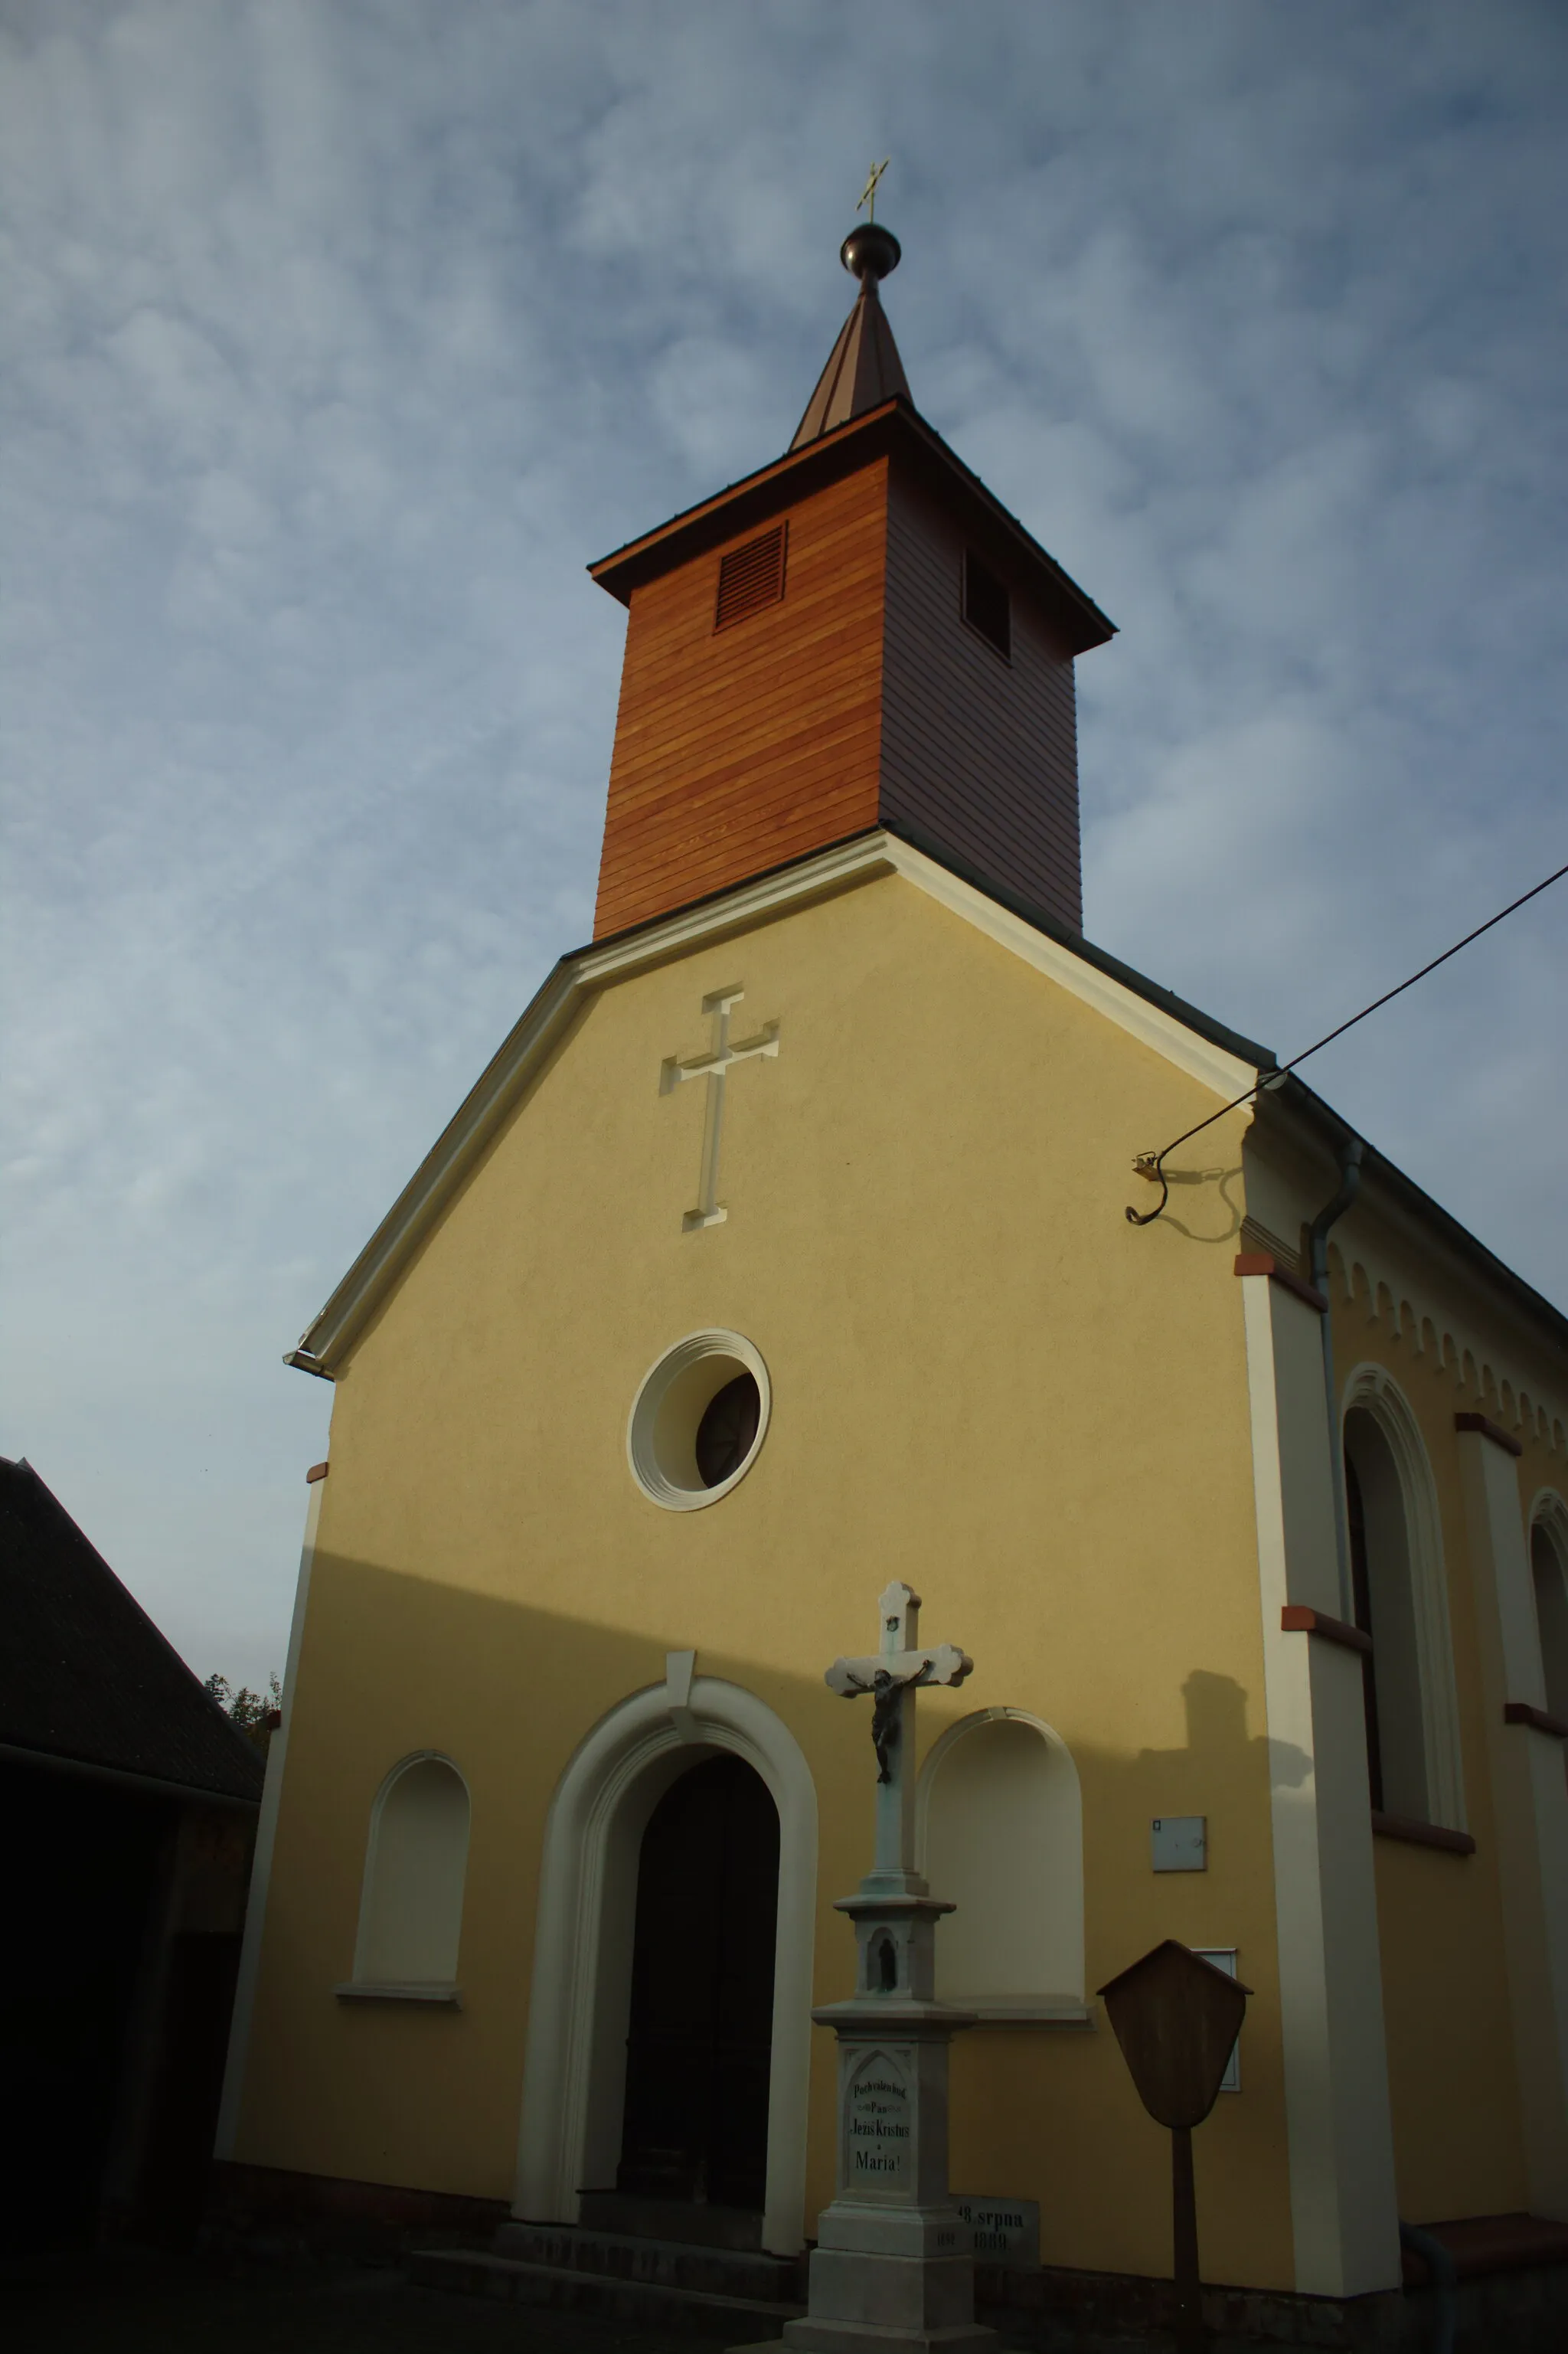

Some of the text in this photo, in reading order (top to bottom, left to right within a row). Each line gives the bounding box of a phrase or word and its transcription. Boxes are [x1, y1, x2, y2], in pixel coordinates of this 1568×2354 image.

[876, 2118, 910, 2137] Kristus
[856, 2150, 900, 2172] Maria!
[978, 2212, 1024, 2232] srpna
